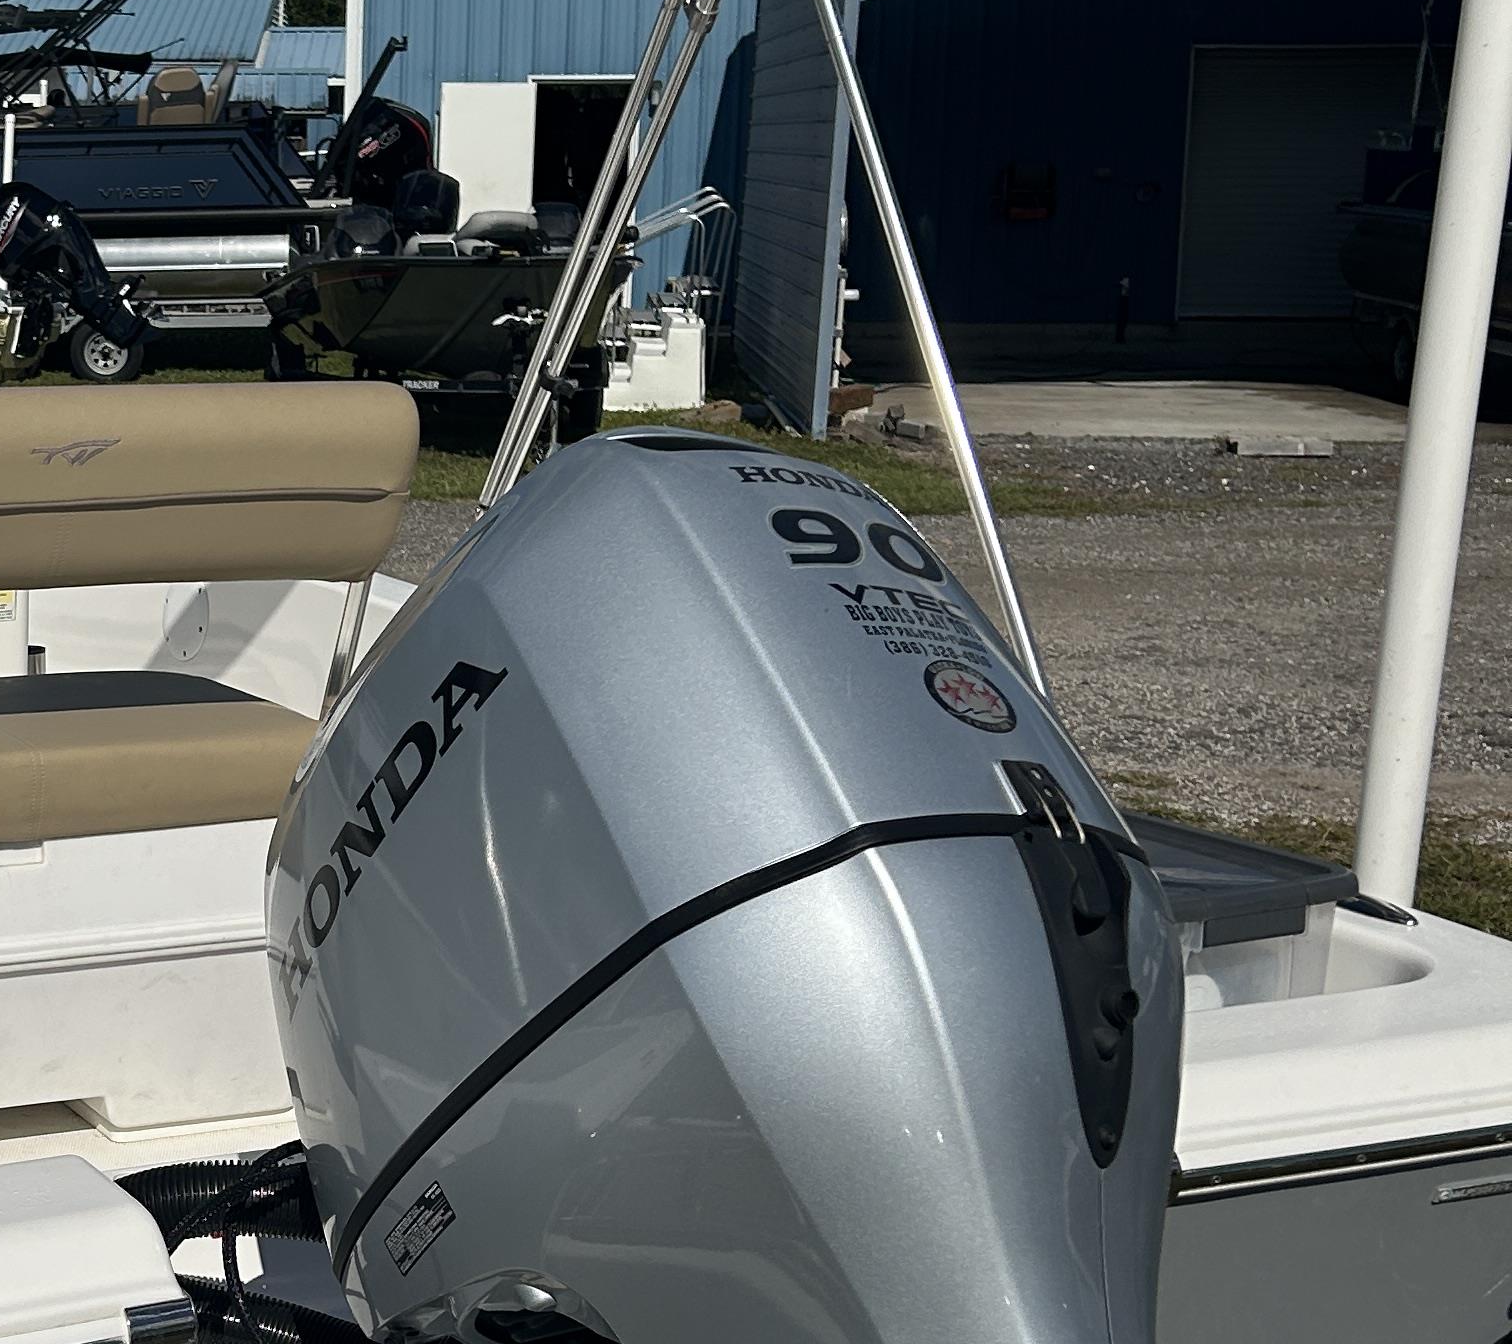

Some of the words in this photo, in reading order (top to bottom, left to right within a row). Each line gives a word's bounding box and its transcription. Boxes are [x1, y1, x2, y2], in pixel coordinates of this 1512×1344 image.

[97, 185, 184, 201] VIAGGIO
[402, 379, 440, 390] TRACKER
[728, 466, 891, 510] HONDA
[770, 507, 947, 584] 90
[828, 583, 970, 624] VTEC
[844, 605, 876, 622] BIG
[876, 605, 916, 625] BOYS
[913, 609, 951, 631] PLAY
[862, 625, 895, 637] EAST
[884, 640, 928, 657] (386)
[278, 660, 509, 1022] HONDA
